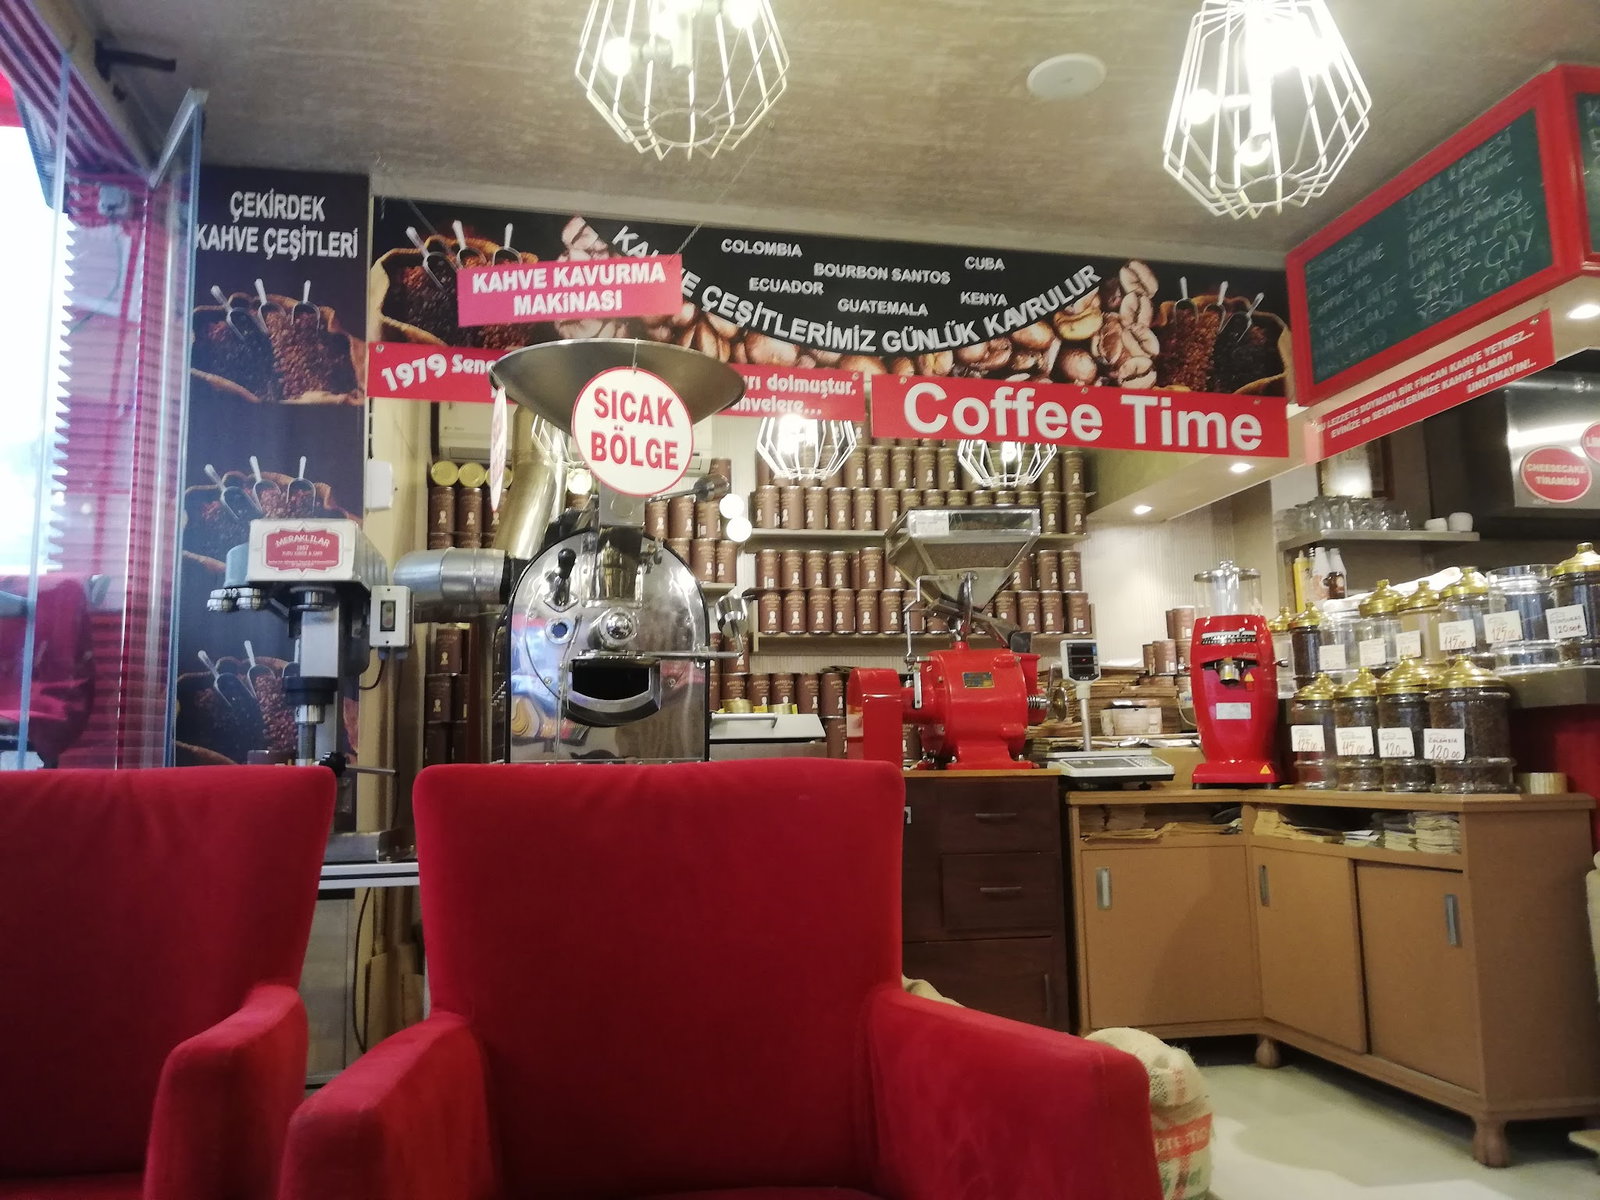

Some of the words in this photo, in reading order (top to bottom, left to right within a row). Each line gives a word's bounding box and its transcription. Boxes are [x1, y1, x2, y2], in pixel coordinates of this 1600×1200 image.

[229, 187, 326, 223] ÇEKİRDEK
[196, 223, 259, 253] KAHVE
[263, 225, 359, 262] ÇEŞİTLERİ
[721, 238, 803, 257] COLOMBIA
[472, 268, 548, 294] KAHVE
[553, 262, 667, 288] KAVURMA
[814, 263, 888, 281] BOURBON
[891, 267, 951, 285] SANTOS
[964, 256, 1005, 272] CUBA
[749, 277, 824, 296] ECUADOR
[960, 291, 1008, 307] KENYA
[701, 285, 877, 352] ÇEŞİTLERİMİZ
[882, 320, 980, 353] GÜNLÜK
[983, 264, 1102, 337] KAVRULUR
[837, 298, 929, 317] GUATEMALA
[381, 353, 447, 392] 1979
[1414, 366, 1448, 388] FİNCAN
[1448, 350, 1482, 374] KAHVE
[1440, 368, 1474, 390] KAHVE
[767, 373, 857, 399] dolmuştur.
[594, 387, 674, 427] SICAK
[904, 382, 1103, 442] Coffee
[1120, 394, 1263, 451] Time
[591, 425, 679, 470] BÖLGE
